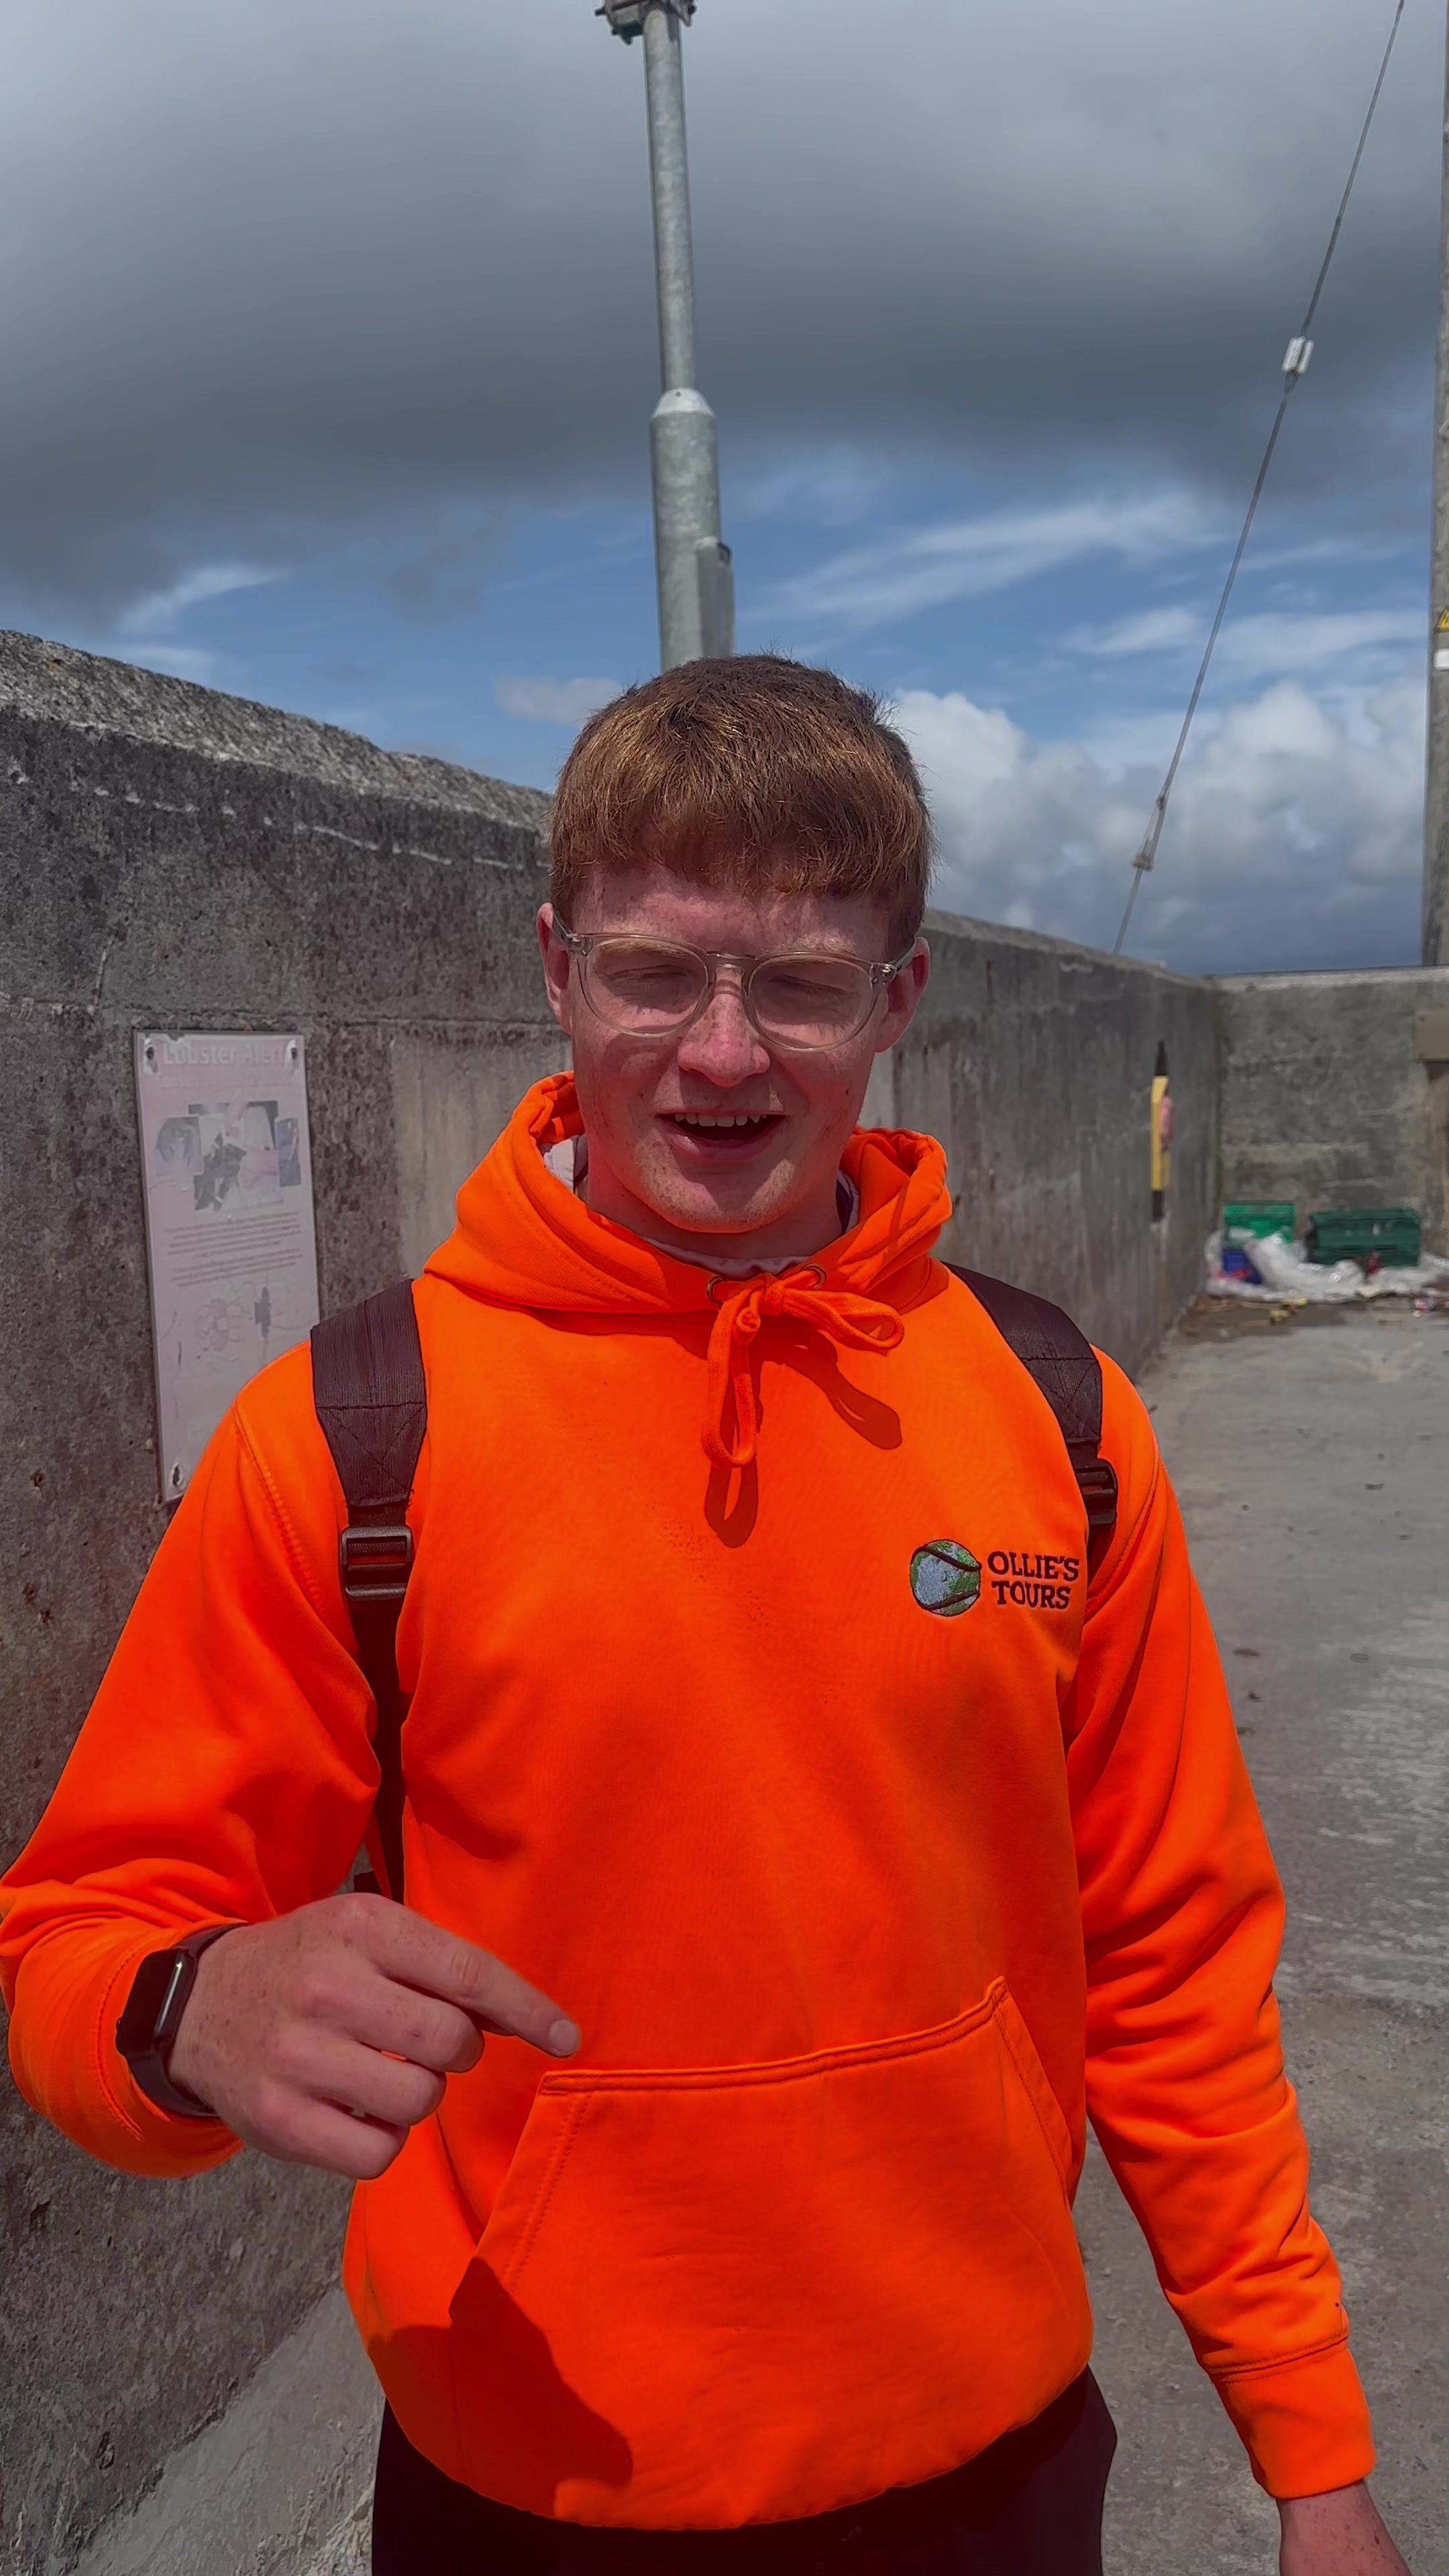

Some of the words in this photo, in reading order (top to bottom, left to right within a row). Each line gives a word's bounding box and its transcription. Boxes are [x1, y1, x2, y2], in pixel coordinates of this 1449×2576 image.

[163, 1041, 236, 1065] Lobster
[987, 1551, 1079, 1582] OLLIE'S
[991, 1580, 1071, 1609] TOURS
